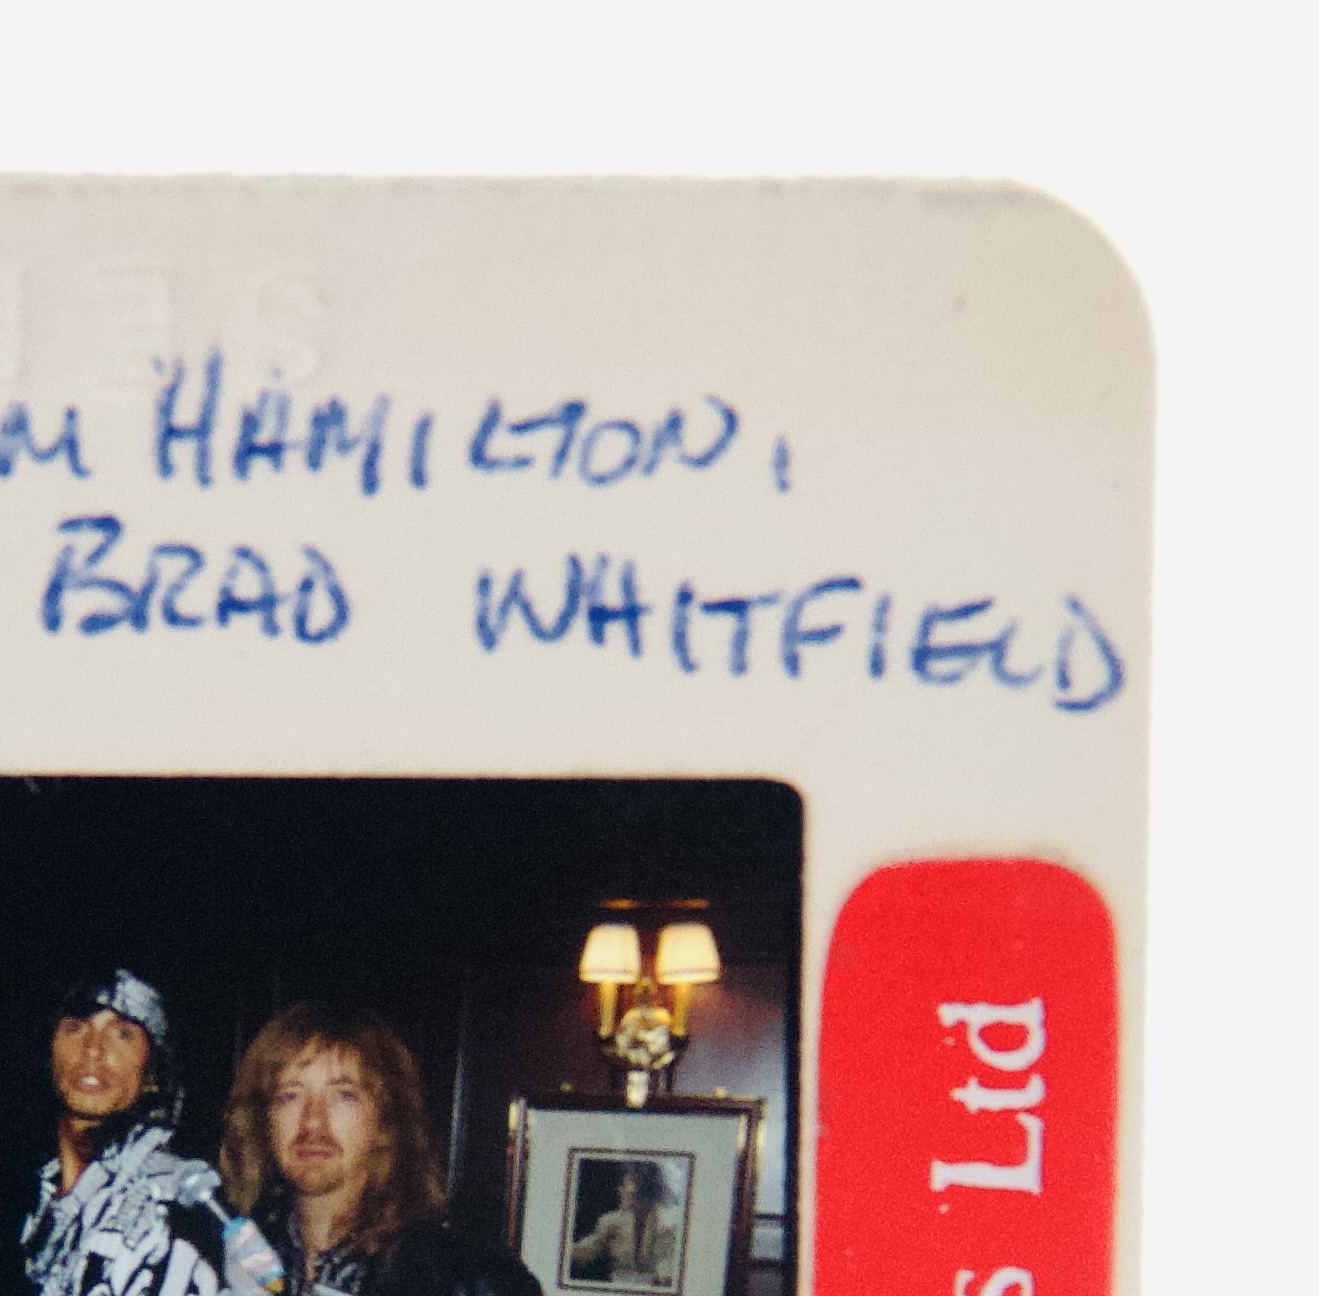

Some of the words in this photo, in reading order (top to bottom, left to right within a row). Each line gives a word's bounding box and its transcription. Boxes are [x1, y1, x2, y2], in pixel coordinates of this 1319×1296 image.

[41, 516, 351, 645] BRAD
[476, 553, 1124, 713] WHITFIELD
[930, 997, 1046, 1196] Ltd
